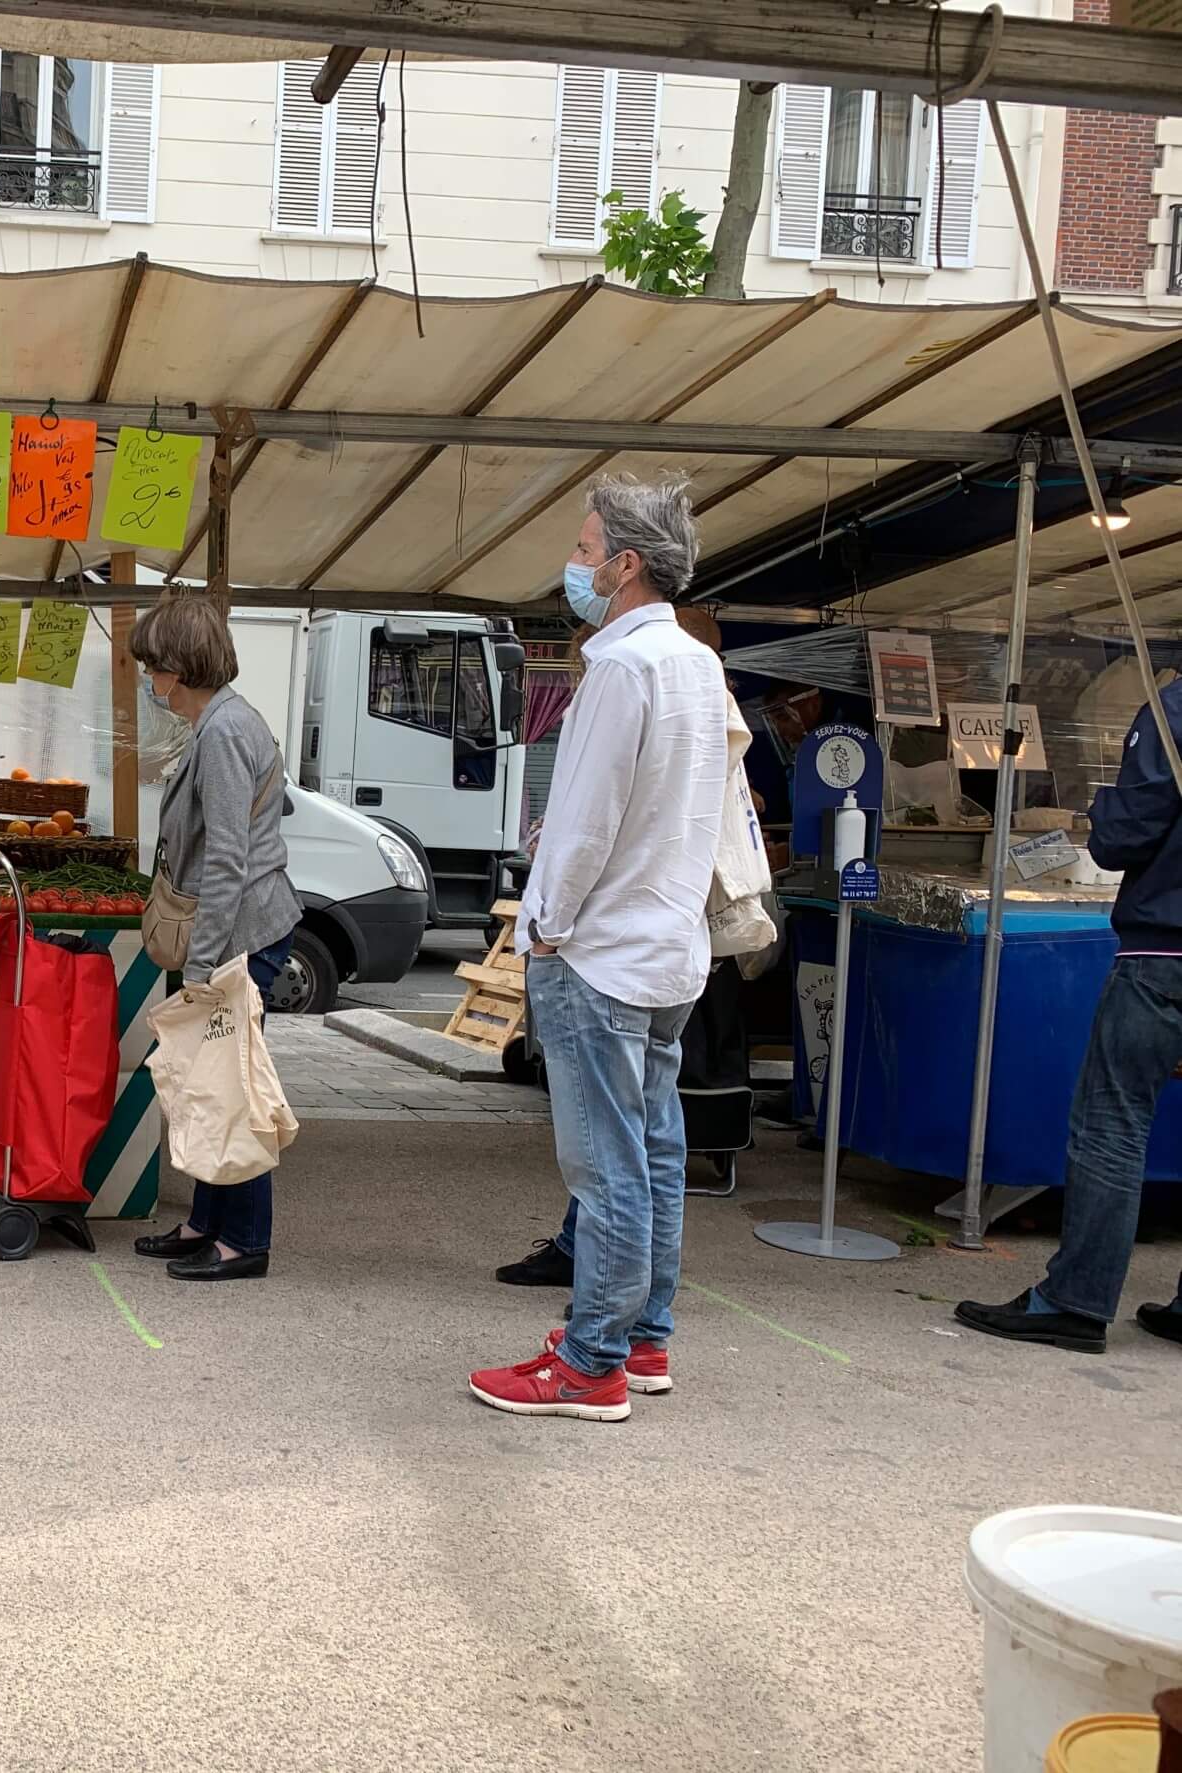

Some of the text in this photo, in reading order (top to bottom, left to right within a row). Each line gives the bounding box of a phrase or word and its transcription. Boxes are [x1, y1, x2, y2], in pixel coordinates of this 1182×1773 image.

[120, 484, 161, 529] 2
[815, 725, 869, 741] SERVEZ-VOUS
[959, 718, 1031, 736] CAISE
[800, 984, 817, 1000] LES
[201, 1025, 236, 1044] APILLO
